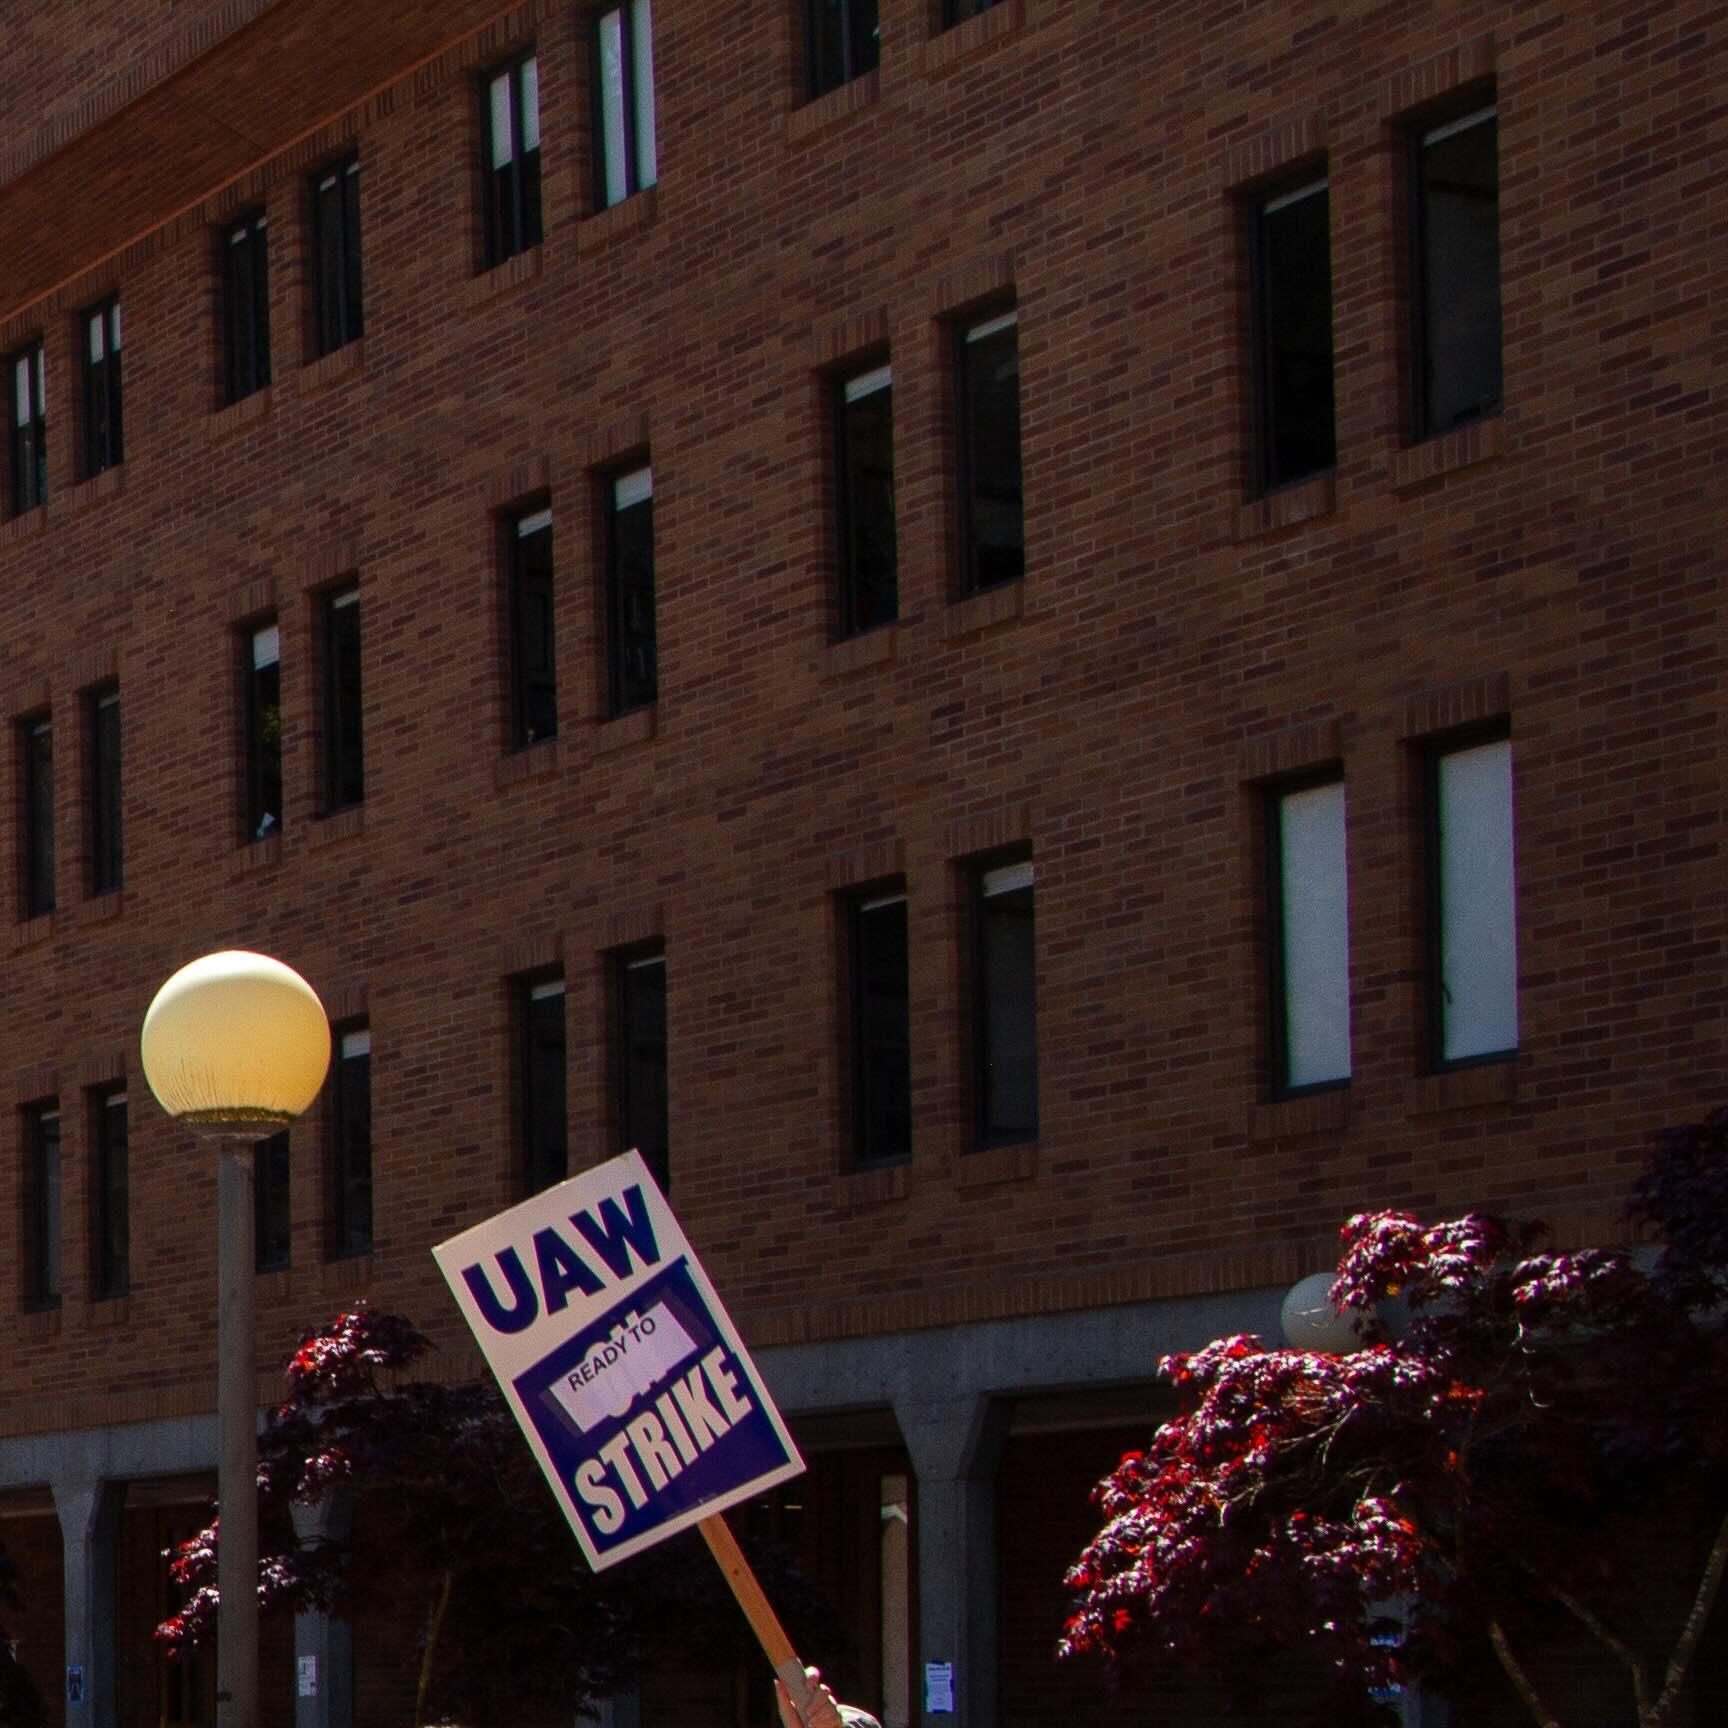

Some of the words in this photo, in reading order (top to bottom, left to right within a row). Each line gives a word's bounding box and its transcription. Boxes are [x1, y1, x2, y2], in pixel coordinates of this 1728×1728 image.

[461, 1183, 661, 1334] UAW
[566, 1336, 638, 1393] READY
[628, 1317, 658, 1345] TO
[575, 1345, 752, 1535] STRIKE
